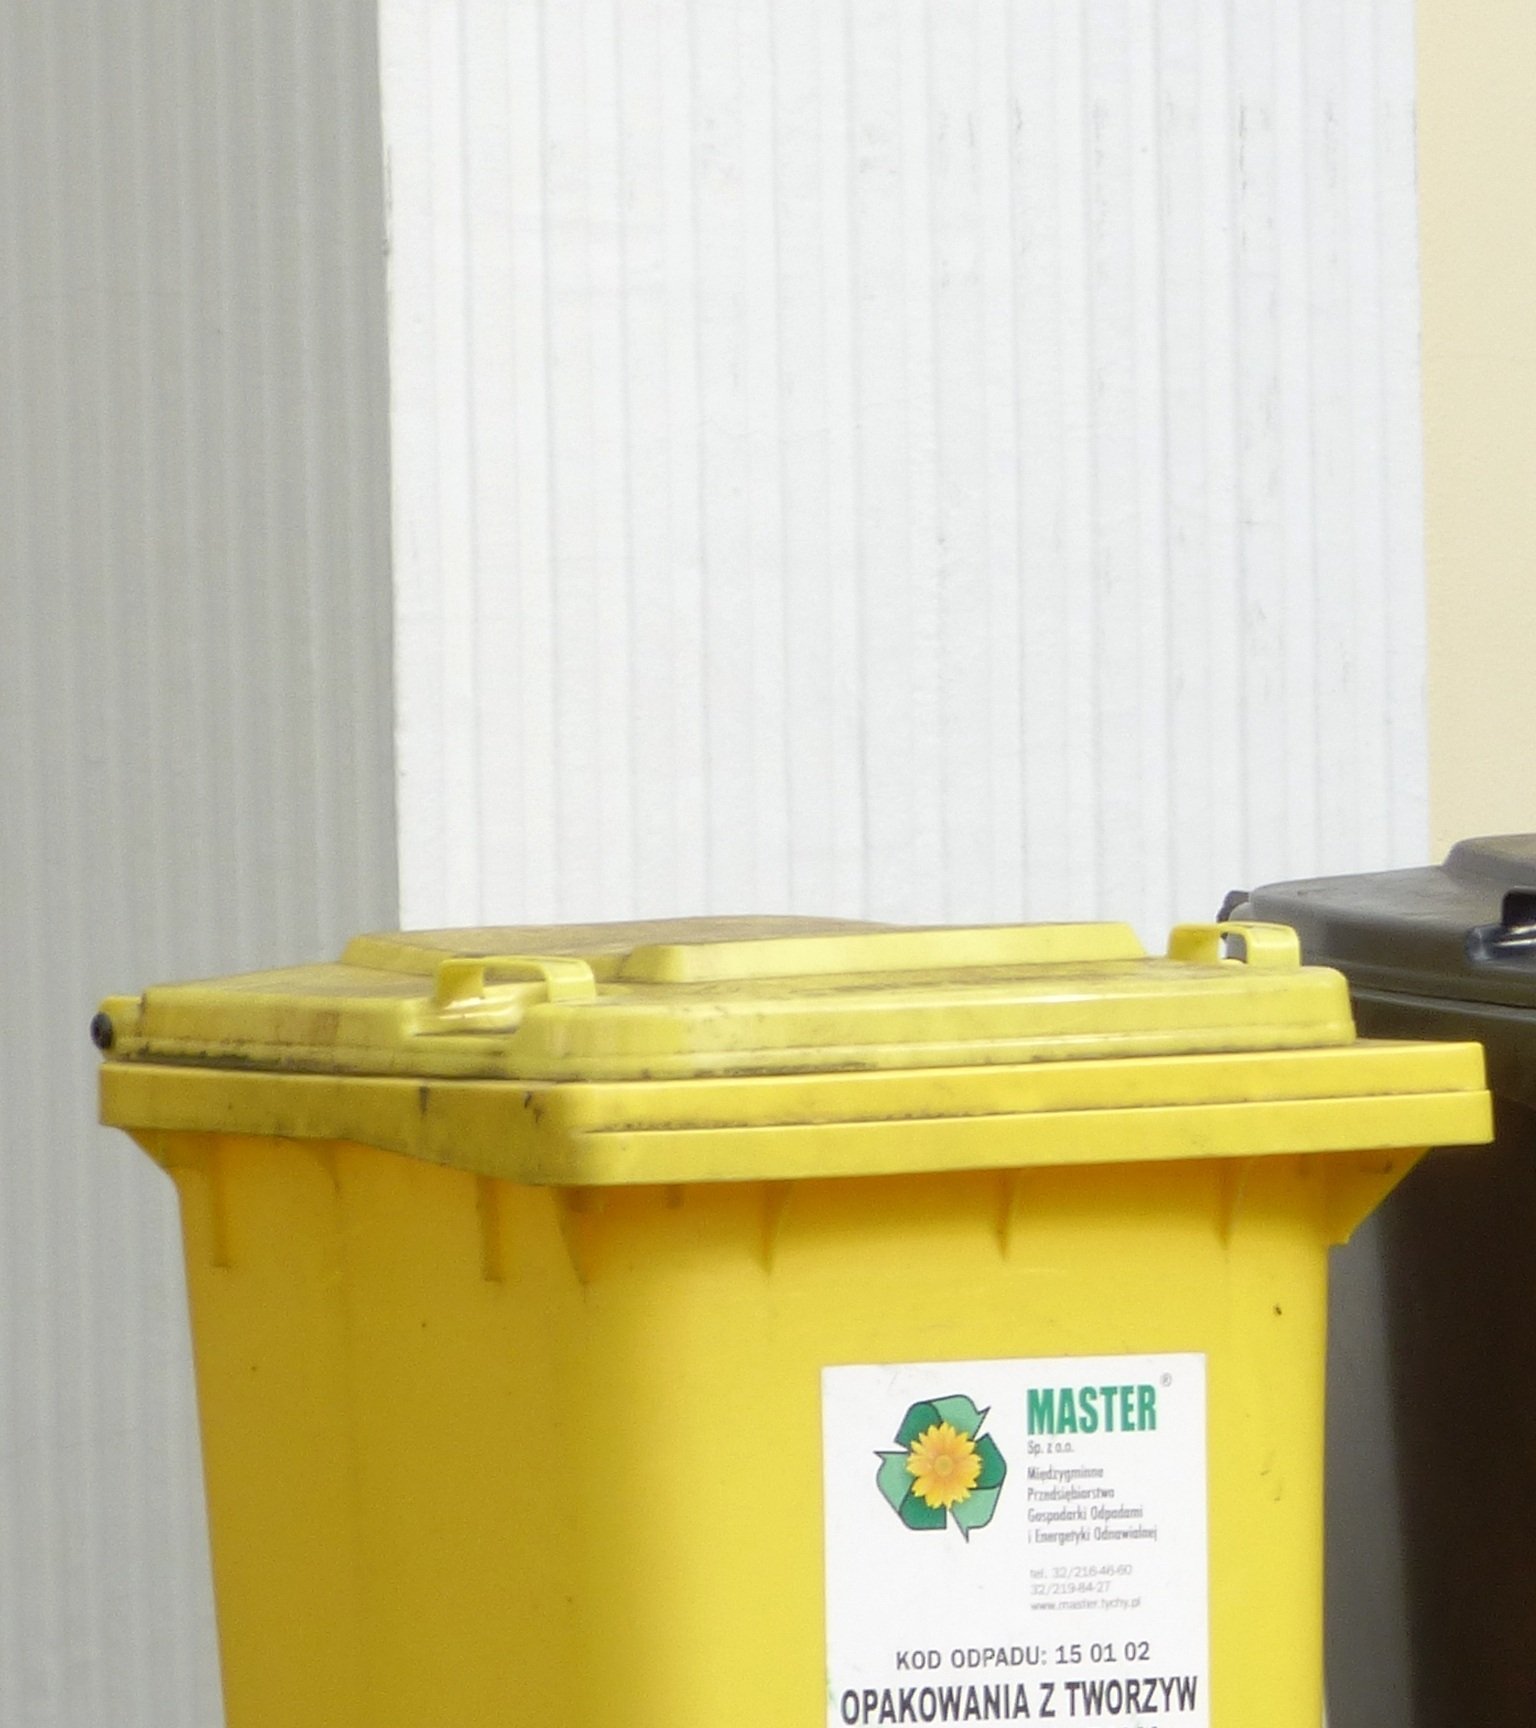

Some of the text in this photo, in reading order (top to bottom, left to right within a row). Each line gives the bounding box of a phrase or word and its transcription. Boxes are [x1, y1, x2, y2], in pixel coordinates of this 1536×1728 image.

[1027, 1384, 1157, 1435] MASTER
[1028, 1440, 1074, 1455] Sp. z o.o.
[1027, 1464, 1103, 1482] Międzygminne
[1028, 1485, 1115, 1502] Przedsiębiorstwo
[1028, 1504, 1143, 1524] Gospodarki Odpadami
[1028, 1530, 1031, 1544] i
[1035, 1526, 1090, 1545] Energetyki
[897, 1642, 1150, 1670] KOD ODPADU: 15 01 02
[841, 1676, 1198, 1725] OPAKOWANIA Z TWORZYW
